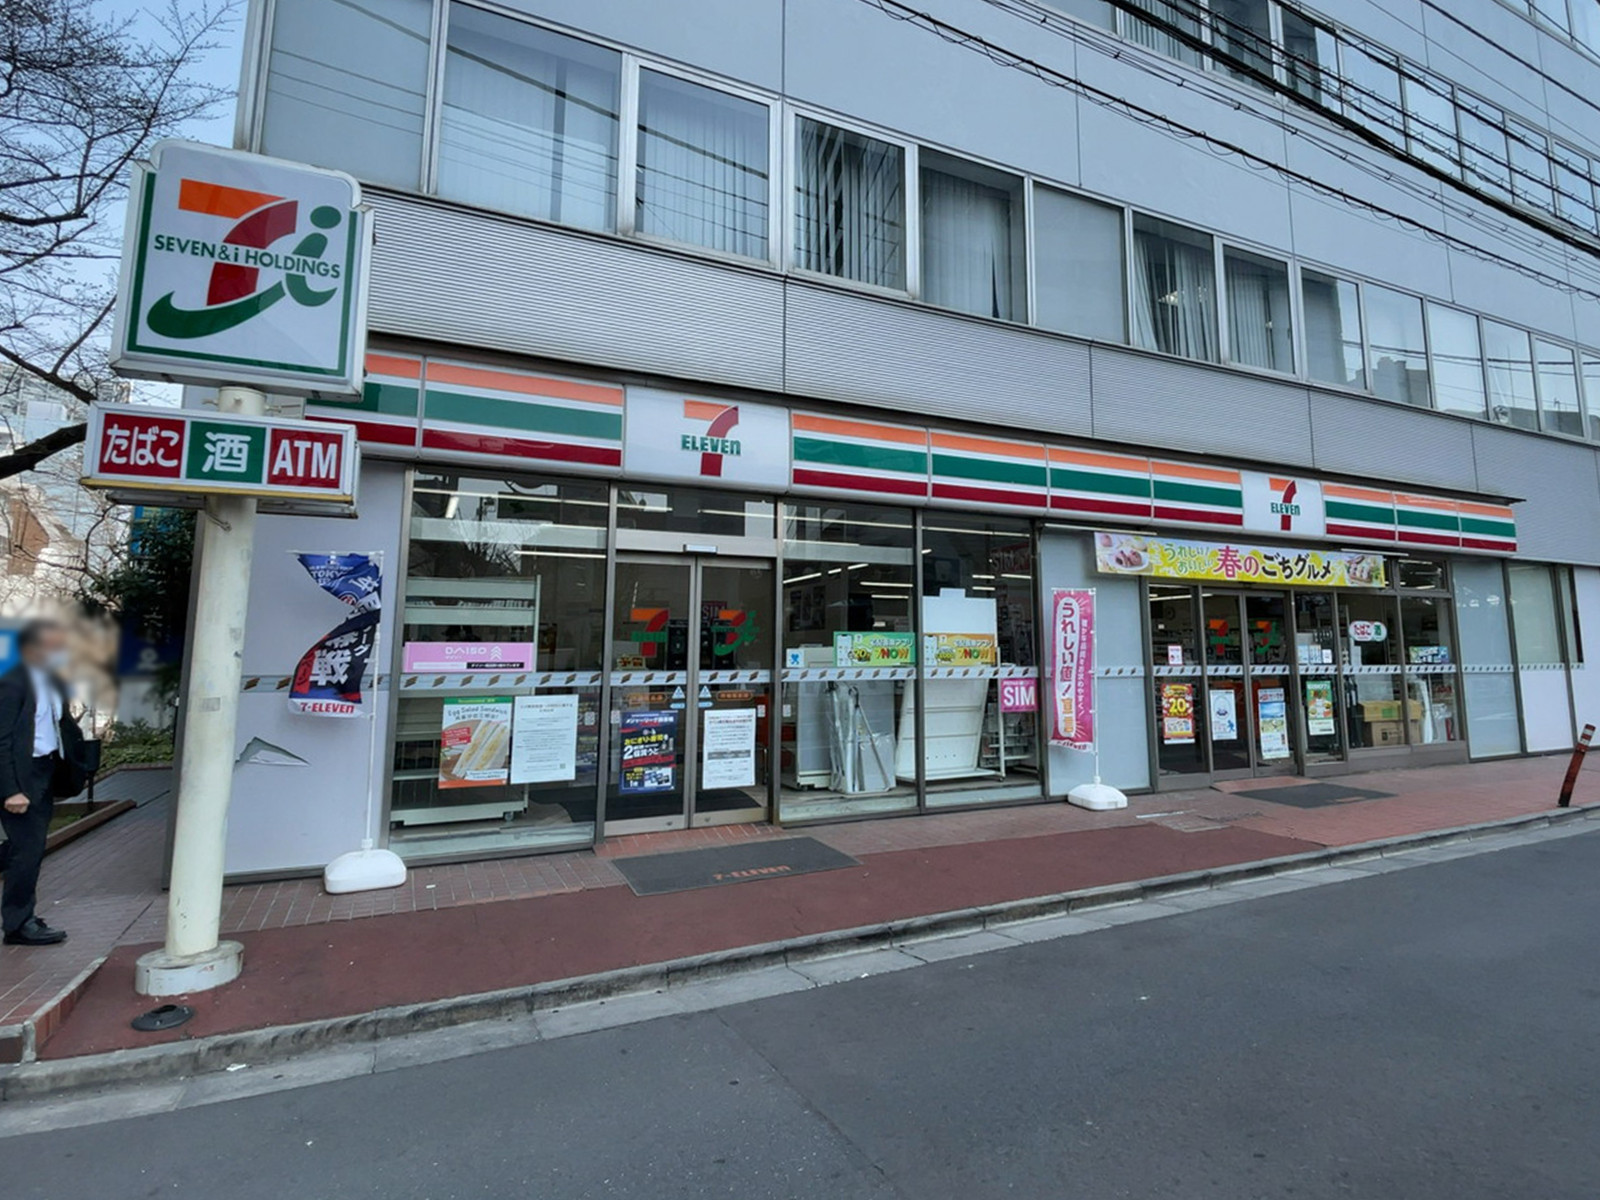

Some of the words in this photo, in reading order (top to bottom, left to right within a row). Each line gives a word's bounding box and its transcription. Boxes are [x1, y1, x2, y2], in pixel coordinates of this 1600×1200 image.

[244, 250, 341, 280] HOLDINGS
[103, 423, 181, 468] たばこ
[201, 430, 252, 474] 酒
[272, 438, 339, 480] ATM
[1003, 686, 1035, 706] SIM
[1168, 698, 1187, 713] 20
